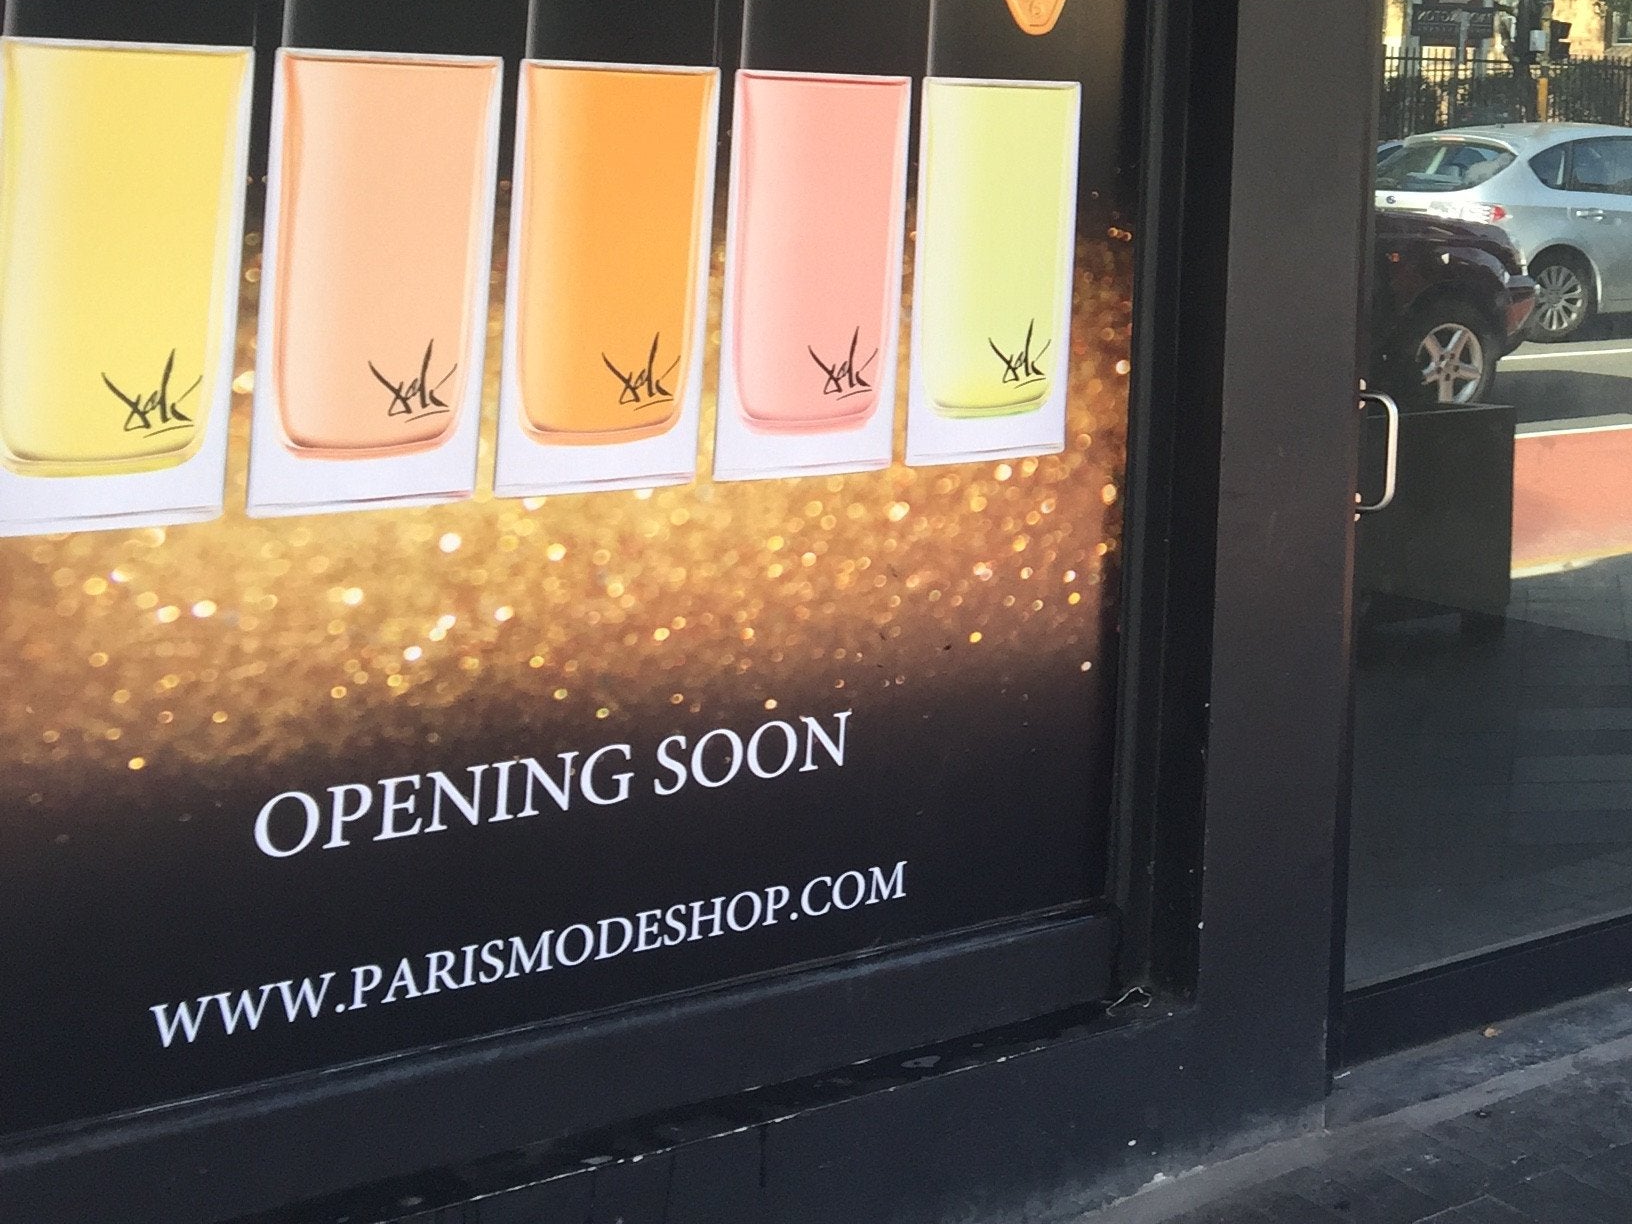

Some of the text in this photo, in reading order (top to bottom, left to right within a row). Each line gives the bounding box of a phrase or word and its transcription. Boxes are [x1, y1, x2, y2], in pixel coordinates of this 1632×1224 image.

[254, 711, 853, 858] OPENING SOON
[149, 861, 908, 1048] WWW.PARISMODESHOP.COM
